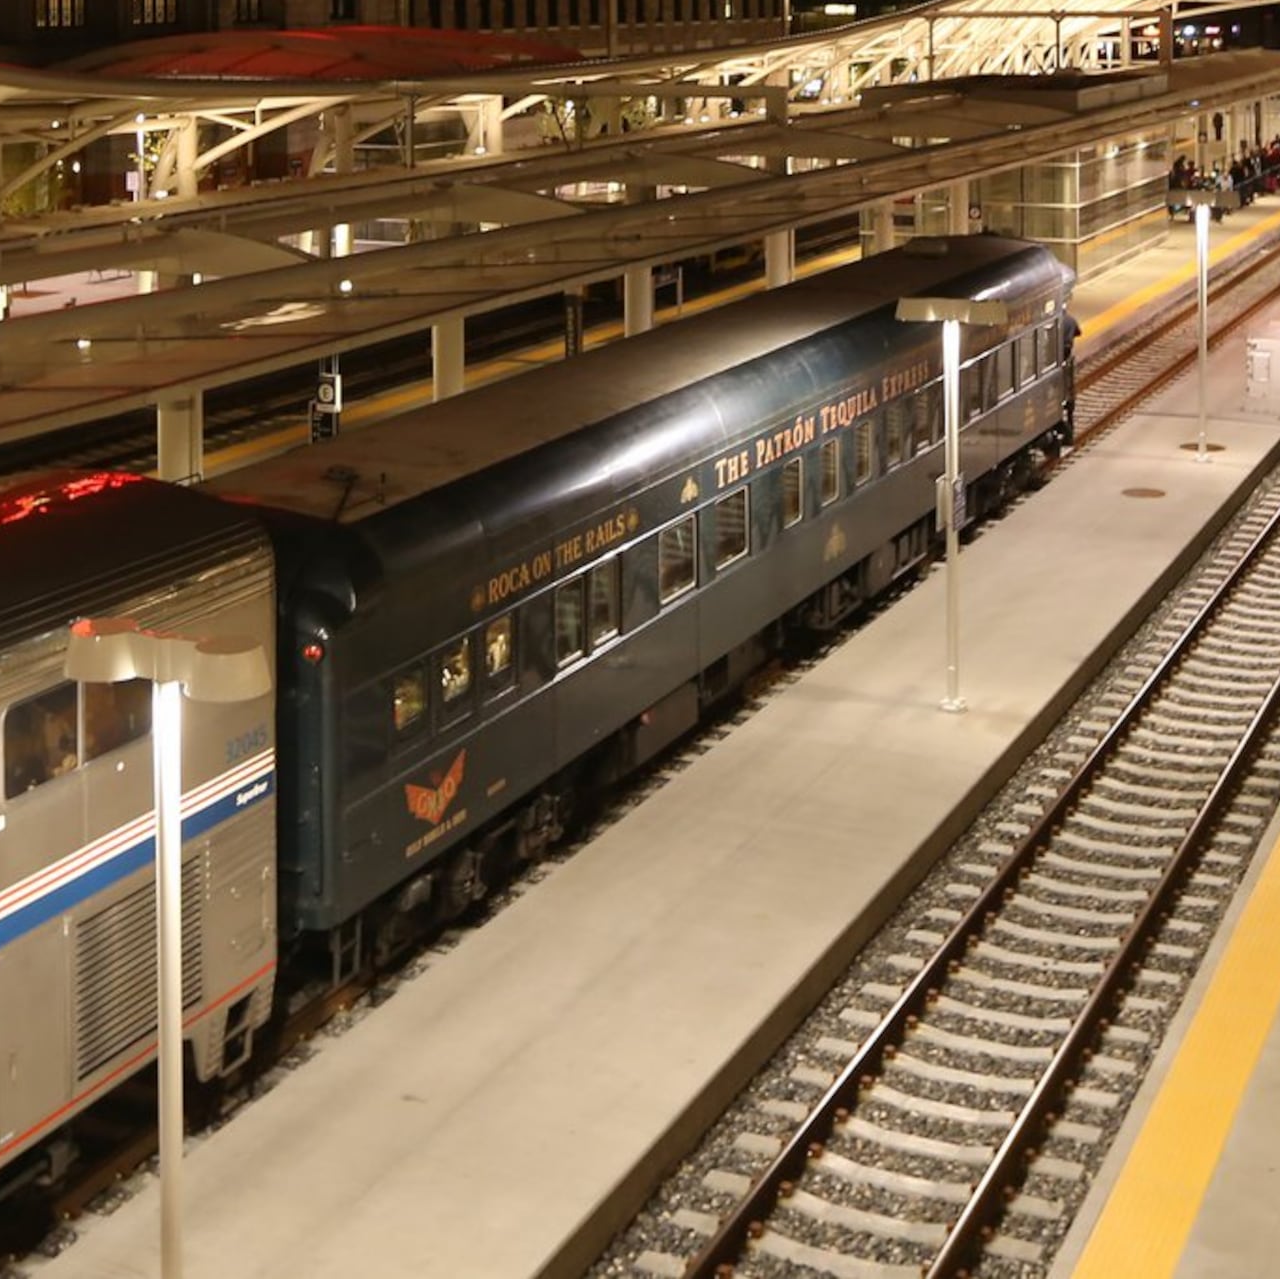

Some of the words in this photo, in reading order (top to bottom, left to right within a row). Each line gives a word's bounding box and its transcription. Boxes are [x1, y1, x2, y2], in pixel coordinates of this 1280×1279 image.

[488, 562, 531, 604] ROCA
[533, 550, 552, 580] ON
[554, 534, 583, 568] THE
[585, 514, 626, 554] RAILS
